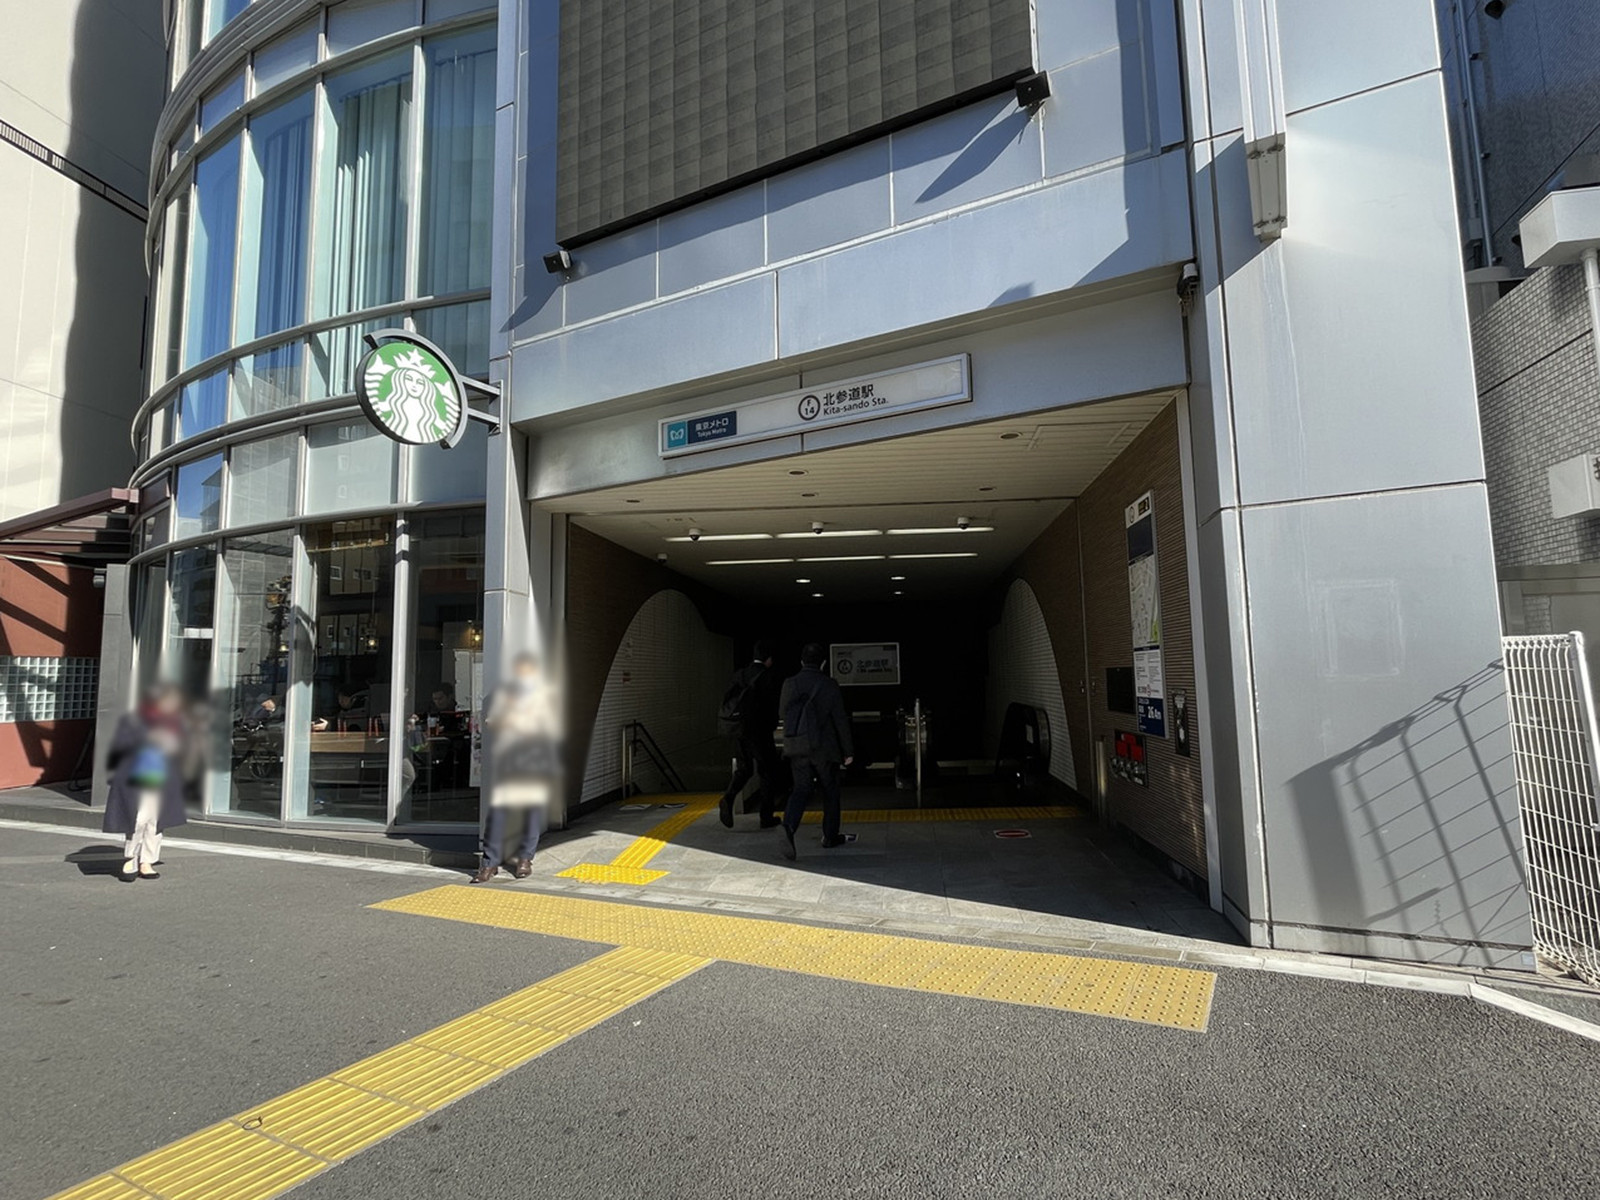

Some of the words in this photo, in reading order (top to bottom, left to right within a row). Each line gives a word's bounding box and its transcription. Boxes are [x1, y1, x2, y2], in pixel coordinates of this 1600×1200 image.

[823, 384, 874, 407] 北参道駅
[804, 406, 815, 415] 14
[823, 400, 870, 416] Kita-sando
[872, 397, 890, 407] Sta.
[695, 417, 729, 431] 東京メトロ
